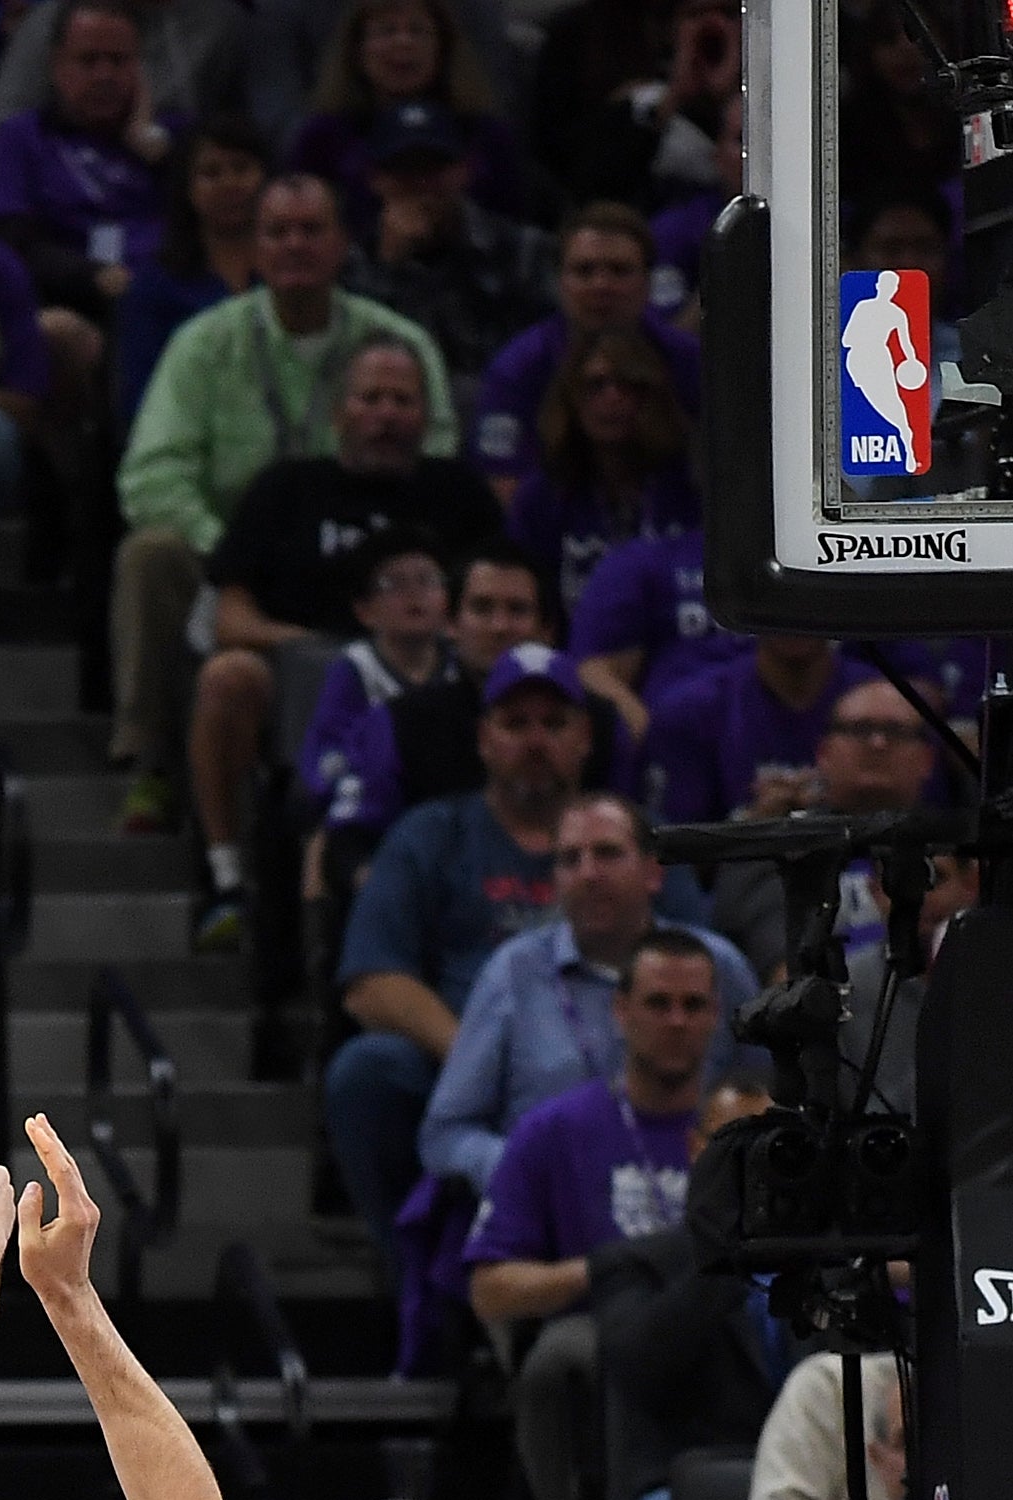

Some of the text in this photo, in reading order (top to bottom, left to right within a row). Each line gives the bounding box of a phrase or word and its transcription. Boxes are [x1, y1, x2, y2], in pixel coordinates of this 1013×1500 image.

[851, 435, 903, 463] NBA
[817, 529, 967, 566] SPALDING
[973, 1268, 1013, 1326] S
